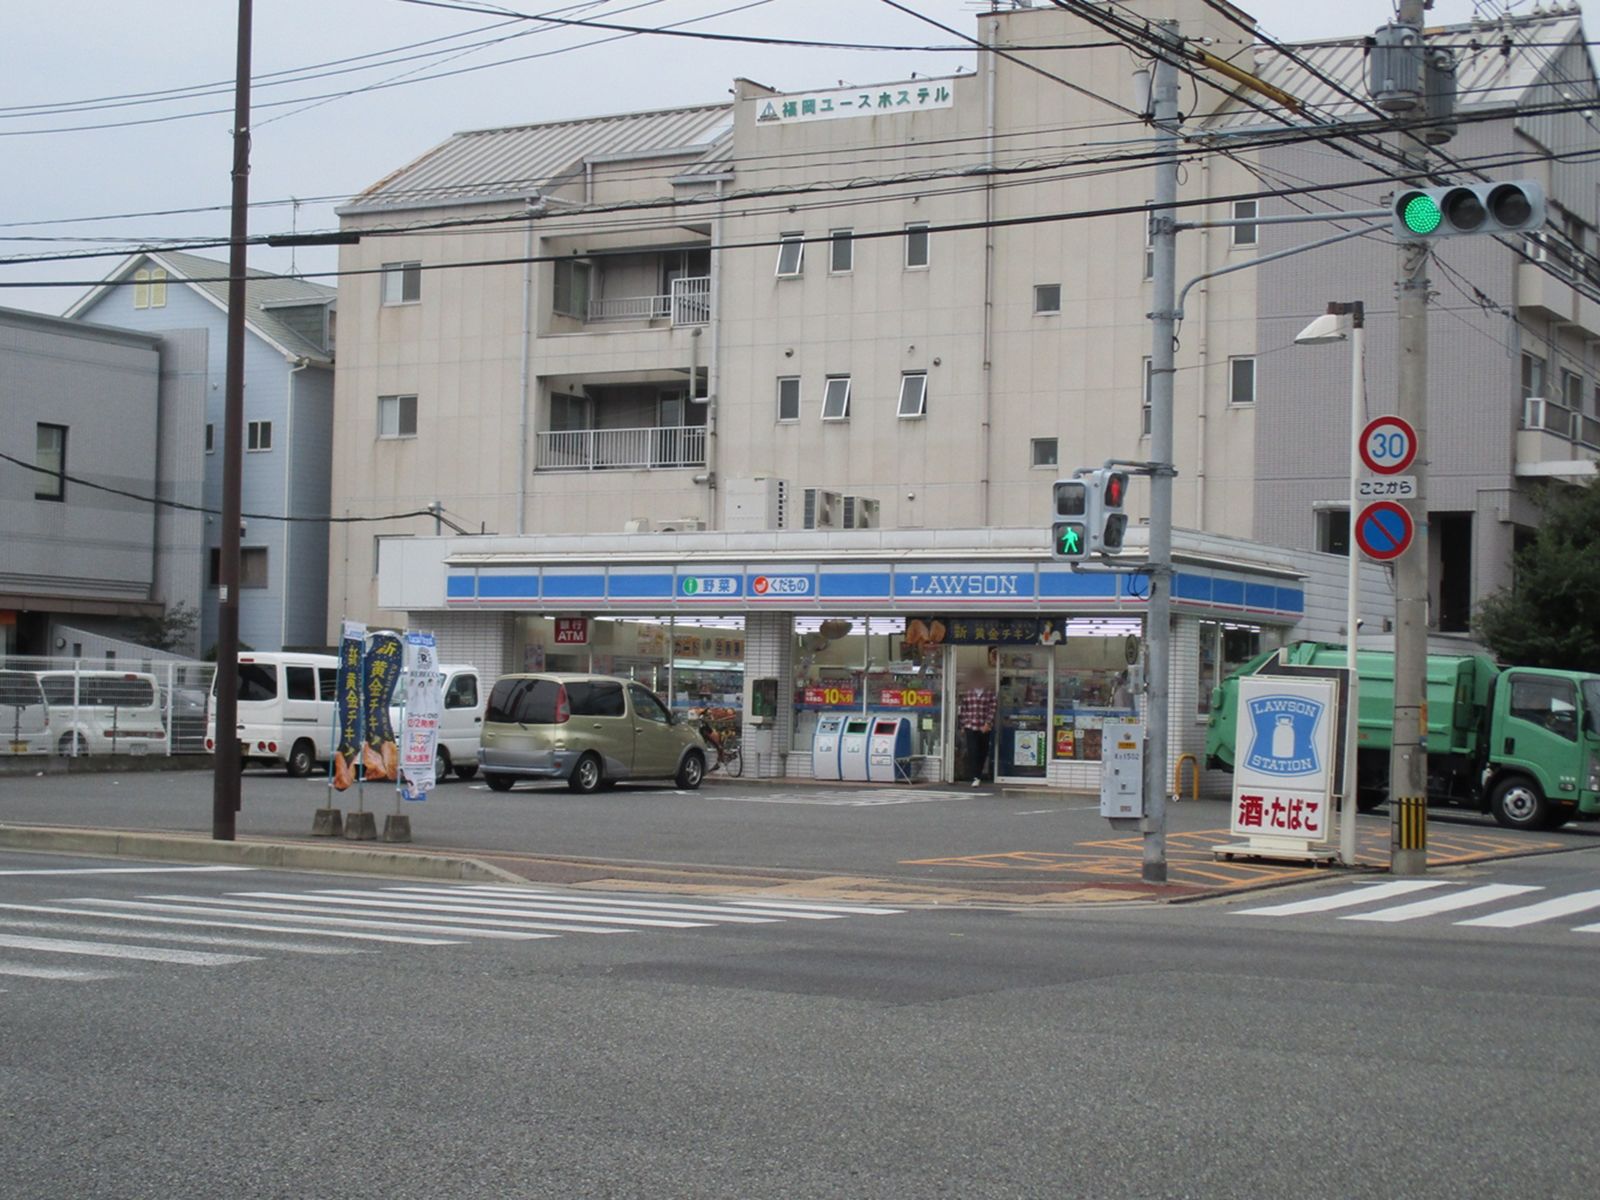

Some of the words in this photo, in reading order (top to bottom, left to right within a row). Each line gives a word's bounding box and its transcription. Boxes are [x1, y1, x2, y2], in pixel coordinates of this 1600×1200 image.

[782, 87, 949, 117] 福岡ユースホステル
[1372, 433, 1404, 458] 30
[1360, 481, 1412, 495] ここから
[703, 579, 730, 592] 野菜
[770, 578, 806, 592] くだもの
[910, 575, 1018, 594] LAWSON
[557, 631, 584, 642] ATM
[368, 661, 388, 745] 黄金チキン
[1253, 700, 1317, 718] LAWSON
[344, 672, 359, 757] 黄金チキン
[1252, 754, 1313, 771] STATION
[1238, 794, 1319, 831] 酒・たばこ
